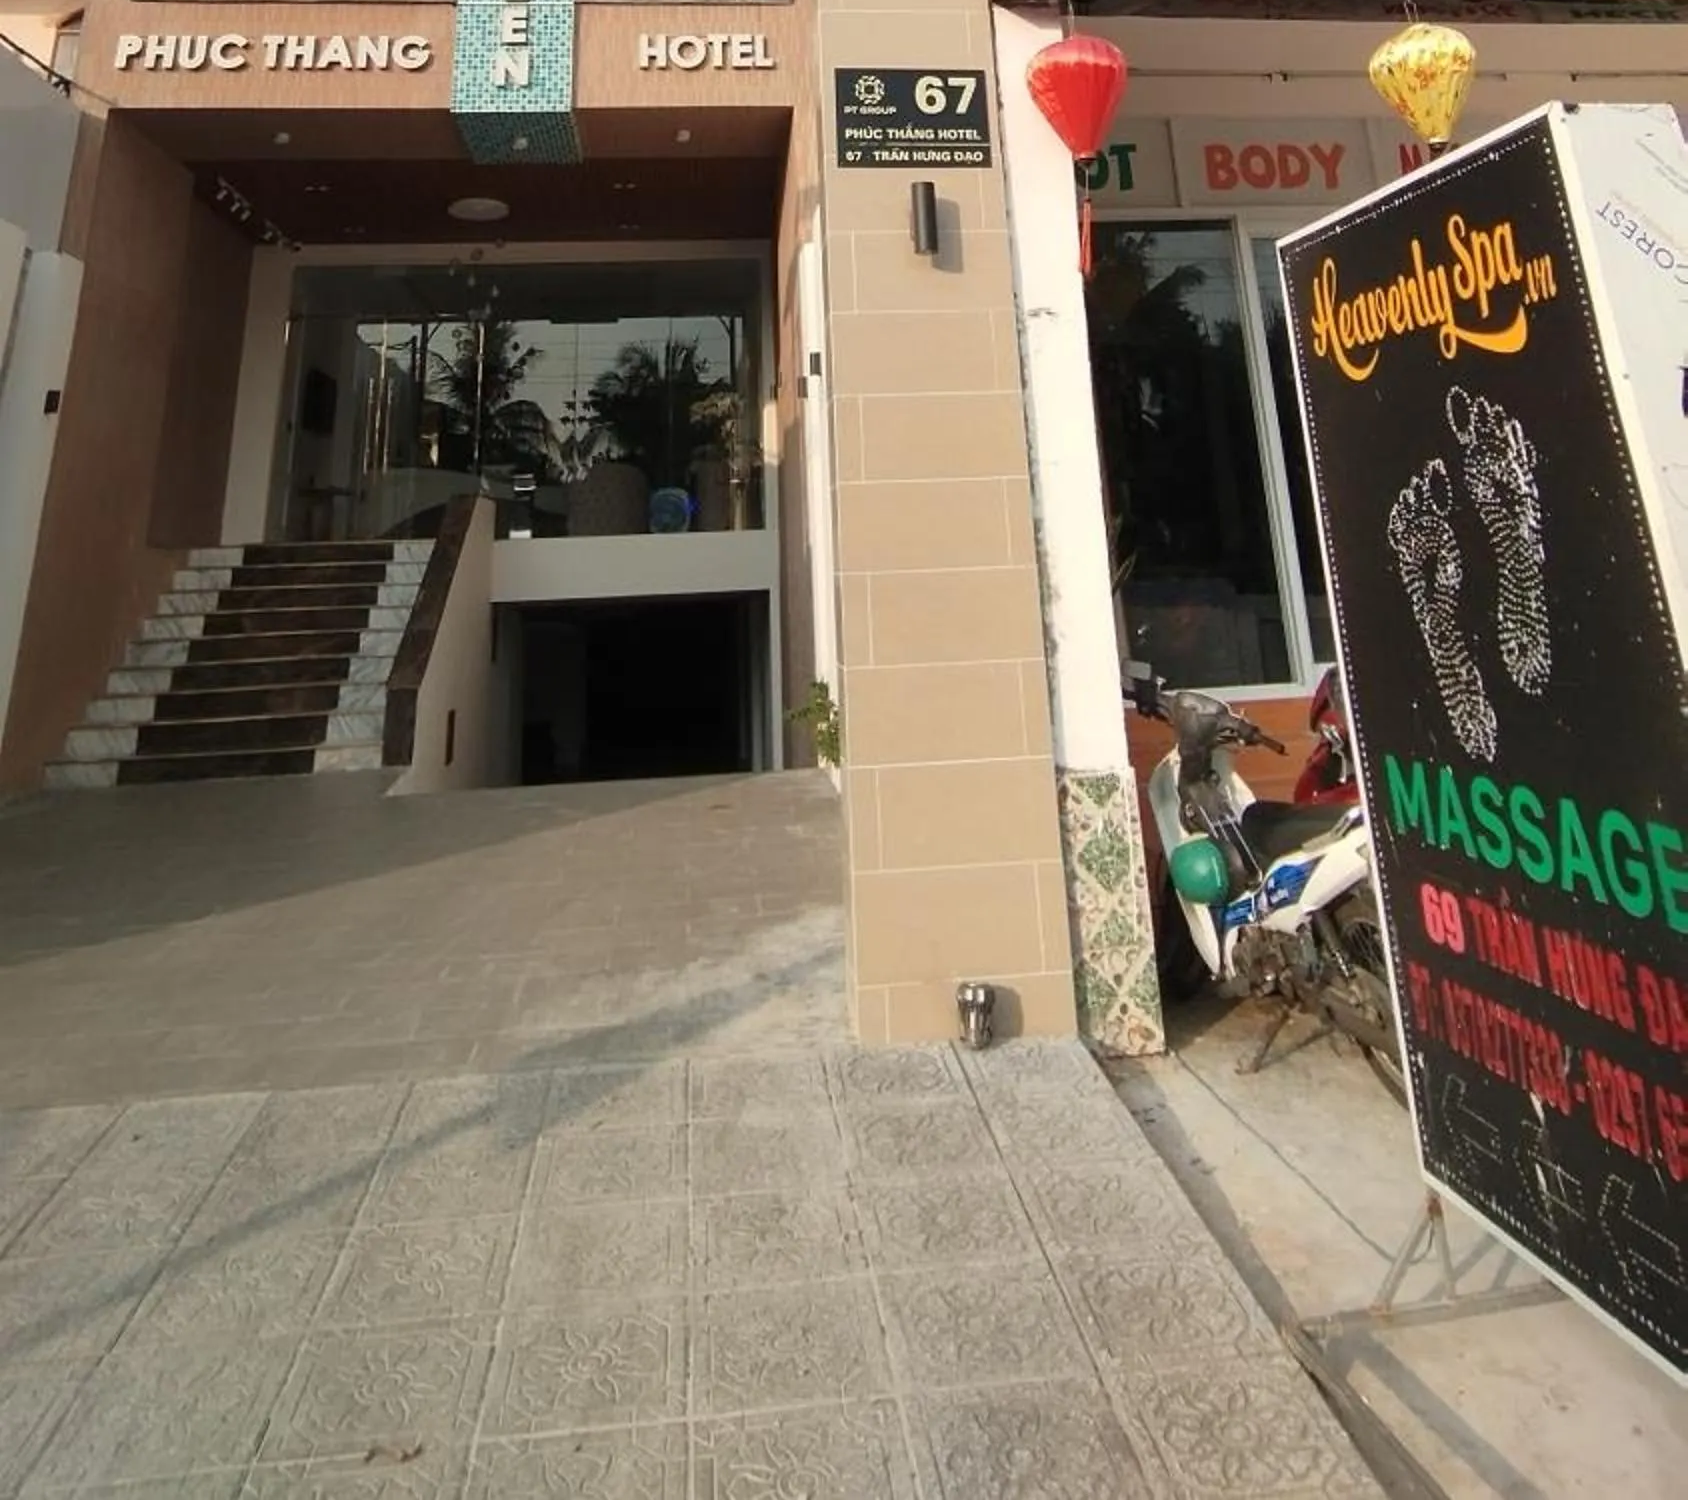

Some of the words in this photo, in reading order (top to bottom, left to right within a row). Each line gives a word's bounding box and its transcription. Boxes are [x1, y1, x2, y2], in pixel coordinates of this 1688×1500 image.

[114, 34, 250, 71] PHUC
[262, 33, 432, 70] THANG
[637, 34, 775, 70] HOTEL
[860, 105, 897, 116] GROUP
[914, 75, 977, 115] 67
[937, 128, 982, 141] HOTEL
[845, 151, 863, 161] 67
[1203, 142, 1345, 192] BODY
[1384, 754, 1688, 935] MASSAGE
[1420, 882, 1466, 953] 69
